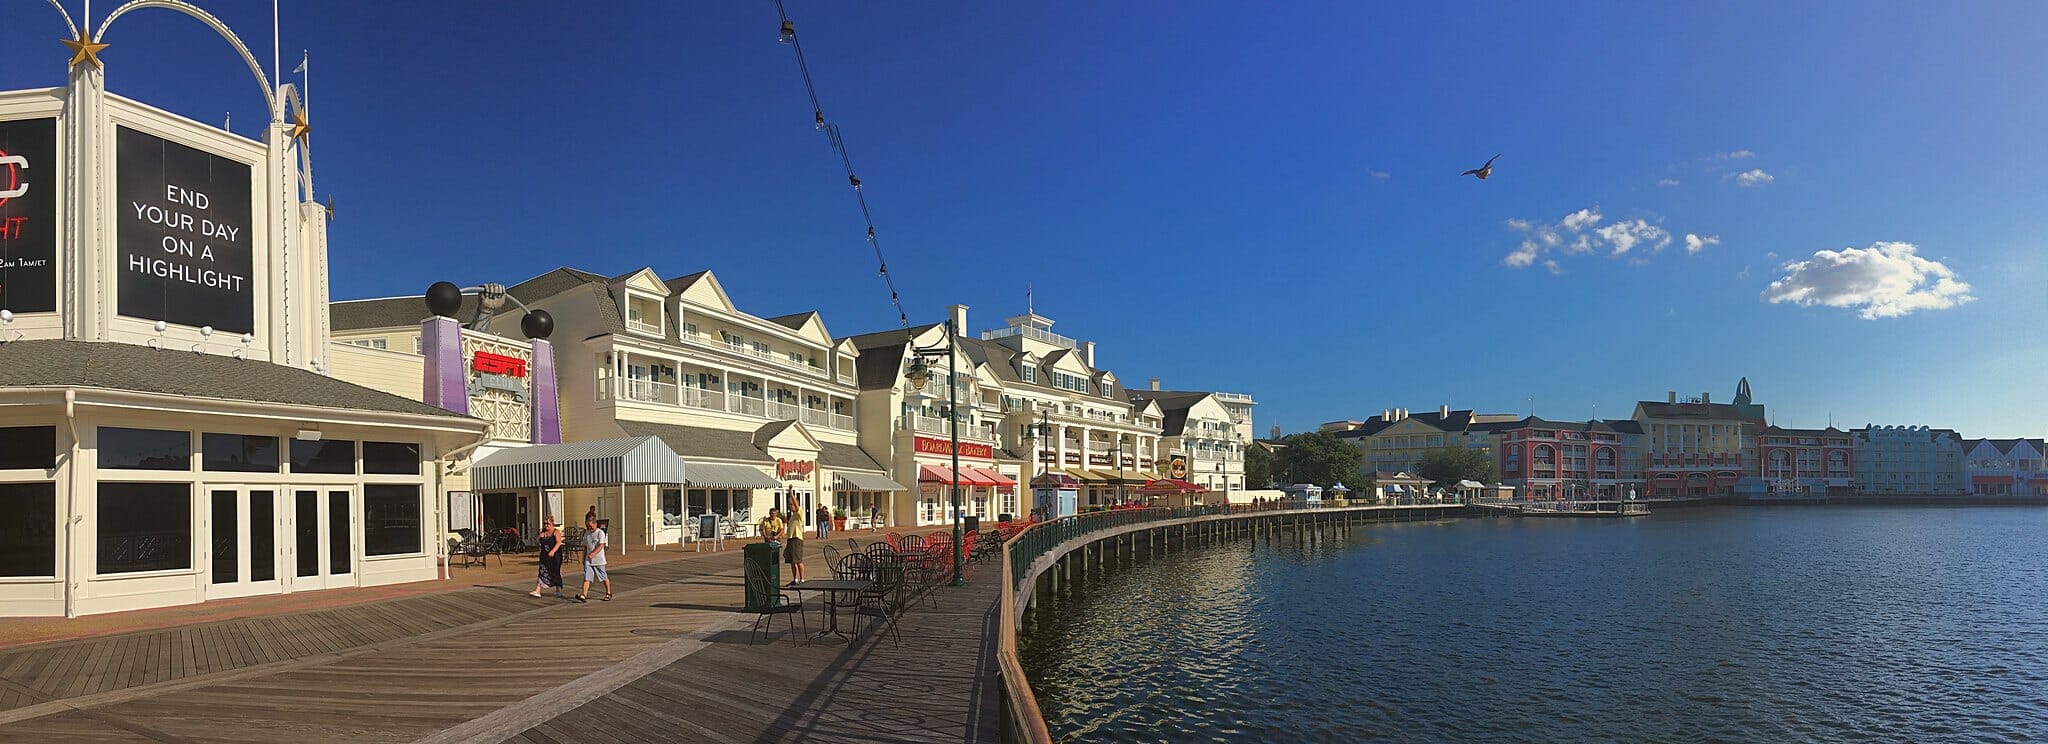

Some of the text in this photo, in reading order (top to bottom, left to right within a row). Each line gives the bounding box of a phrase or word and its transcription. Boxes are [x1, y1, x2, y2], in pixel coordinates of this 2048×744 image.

[167, 184, 209, 210] END
[132, 201, 239, 242] YOUR DAY
[162, 236, 214, 262] ON A
[129, 253, 244, 292] HIGHLIGHT
[474, 351, 526, 377] ESPN
[490, 377, 514, 388] CLUB
[922, 440, 963, 453] BOARDWK
